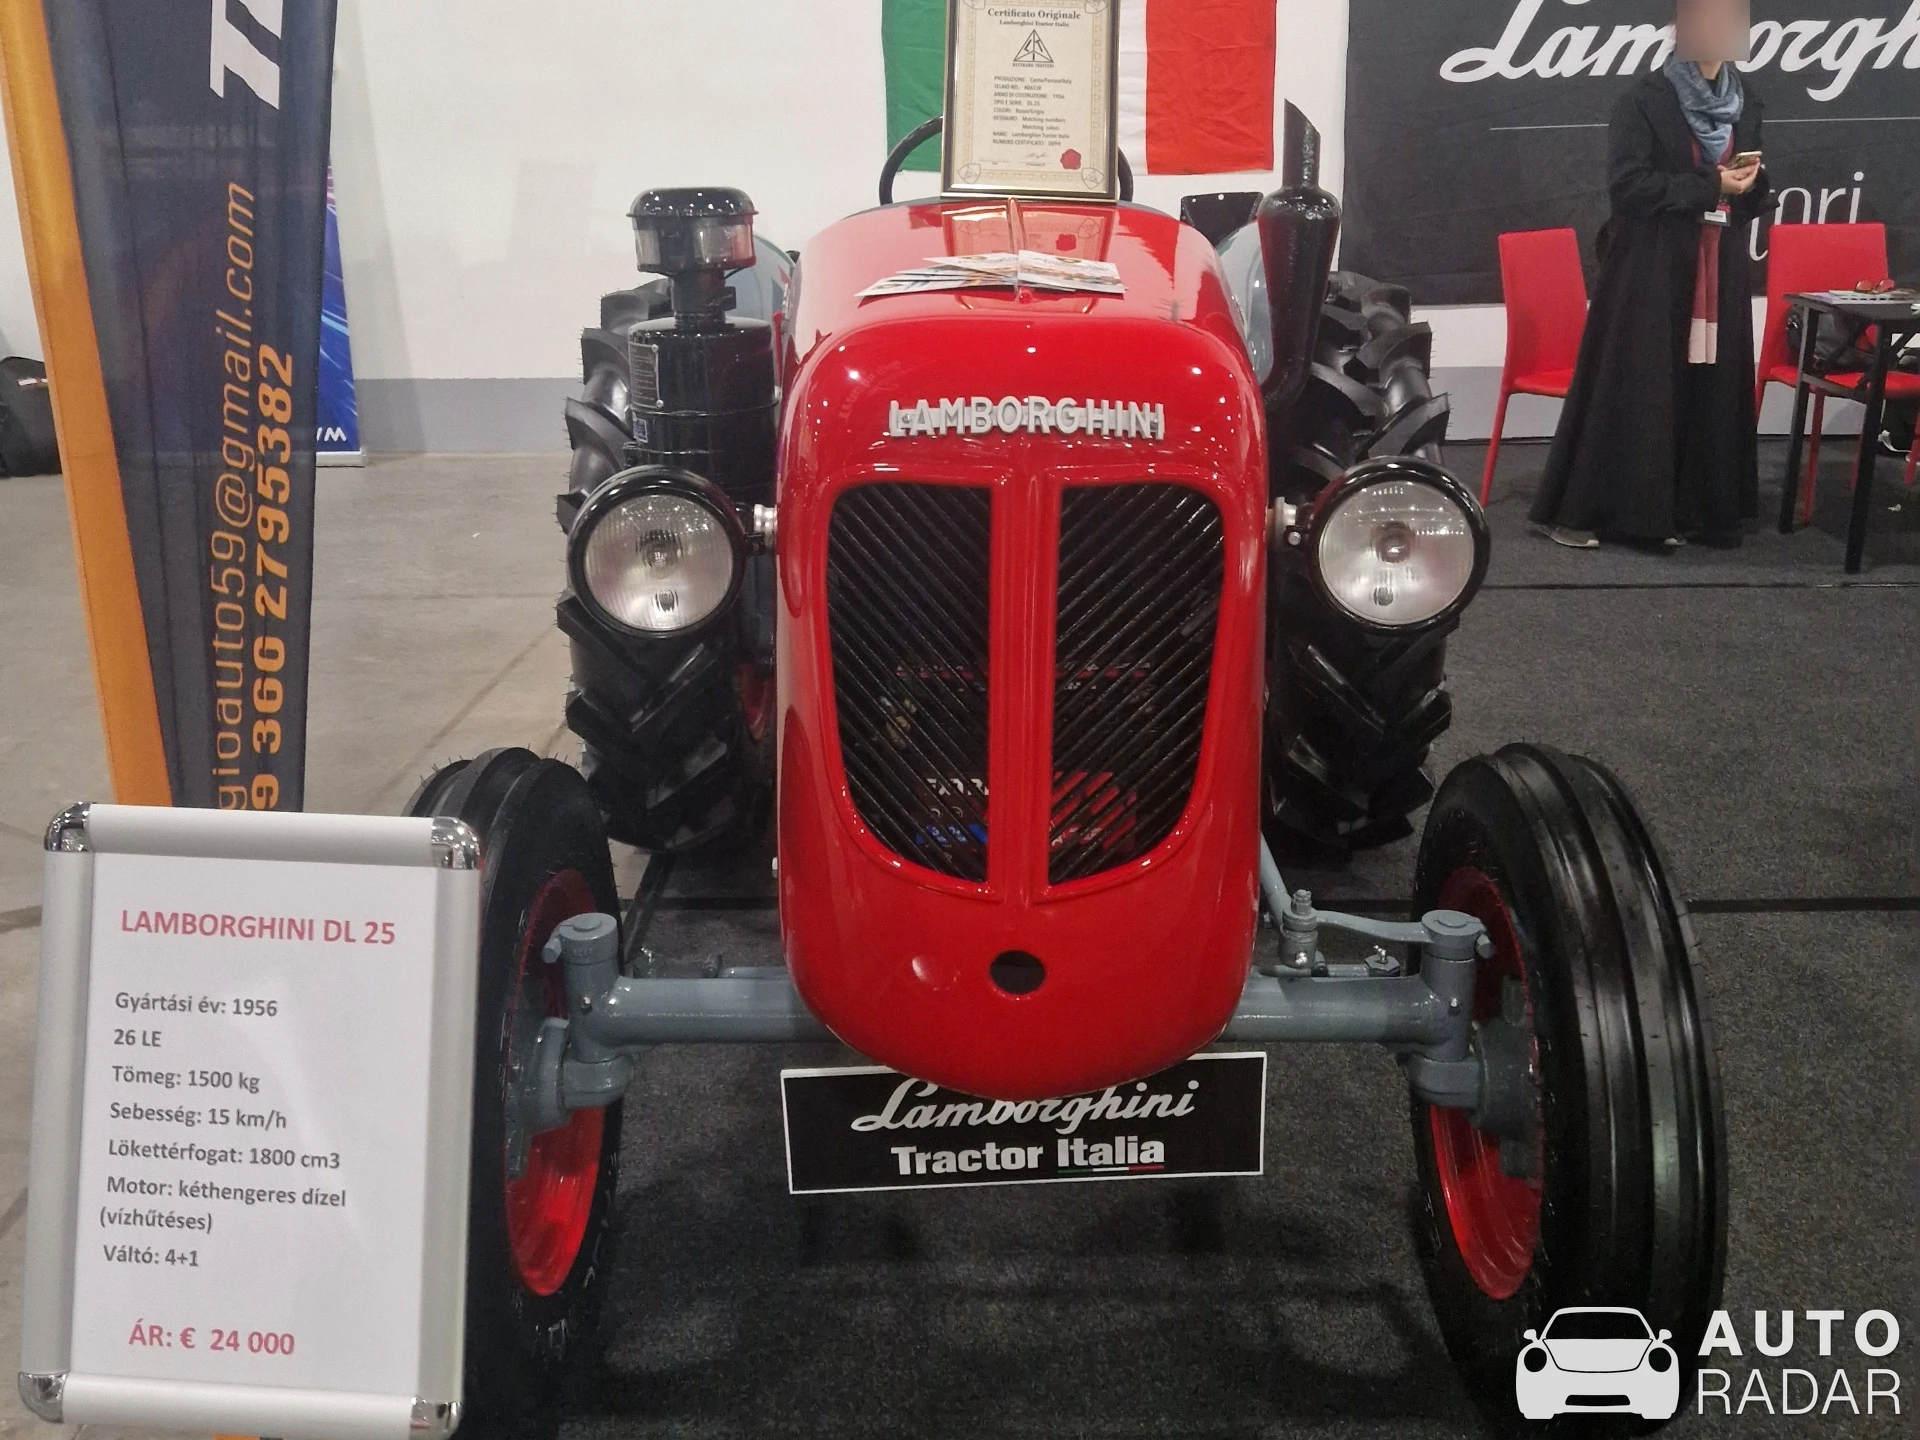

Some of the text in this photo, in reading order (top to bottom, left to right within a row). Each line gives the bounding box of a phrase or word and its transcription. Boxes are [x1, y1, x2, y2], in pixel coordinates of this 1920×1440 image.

[988, 8, 1081, 20] Certificato Originale
[889, 396, 1165, 440] LAMBORGHINI
[253, 343, 293, 621] 2795382
[251, 636, 287, 754] 360
[121, 909, 396, 945] LAMBORGHINI DL 25
[115, 991, 278, 1017] Gyártási év: 1956
[113, 1029, 162, 1048] 26 LE
[111, 1066, 260, 1094] Tömeg: 1500 kg
[109, 1102, 287, 1131] Sebesség: 15 km/h
[108, 1139, 340, 1170] Lökettérfogat: 1800 cm3
[891, 1136, 1165, 1175] Tractor Italia
[107, 1176, 346, 1207] Motor: kéthengeres dízel
[99, 1206, 213, 1234] (vízhűtéses)
[103, 1244, 199, 1267] Váltó: 4+1
[128, 1318, 295, 1355] ÁR: € 24 000
